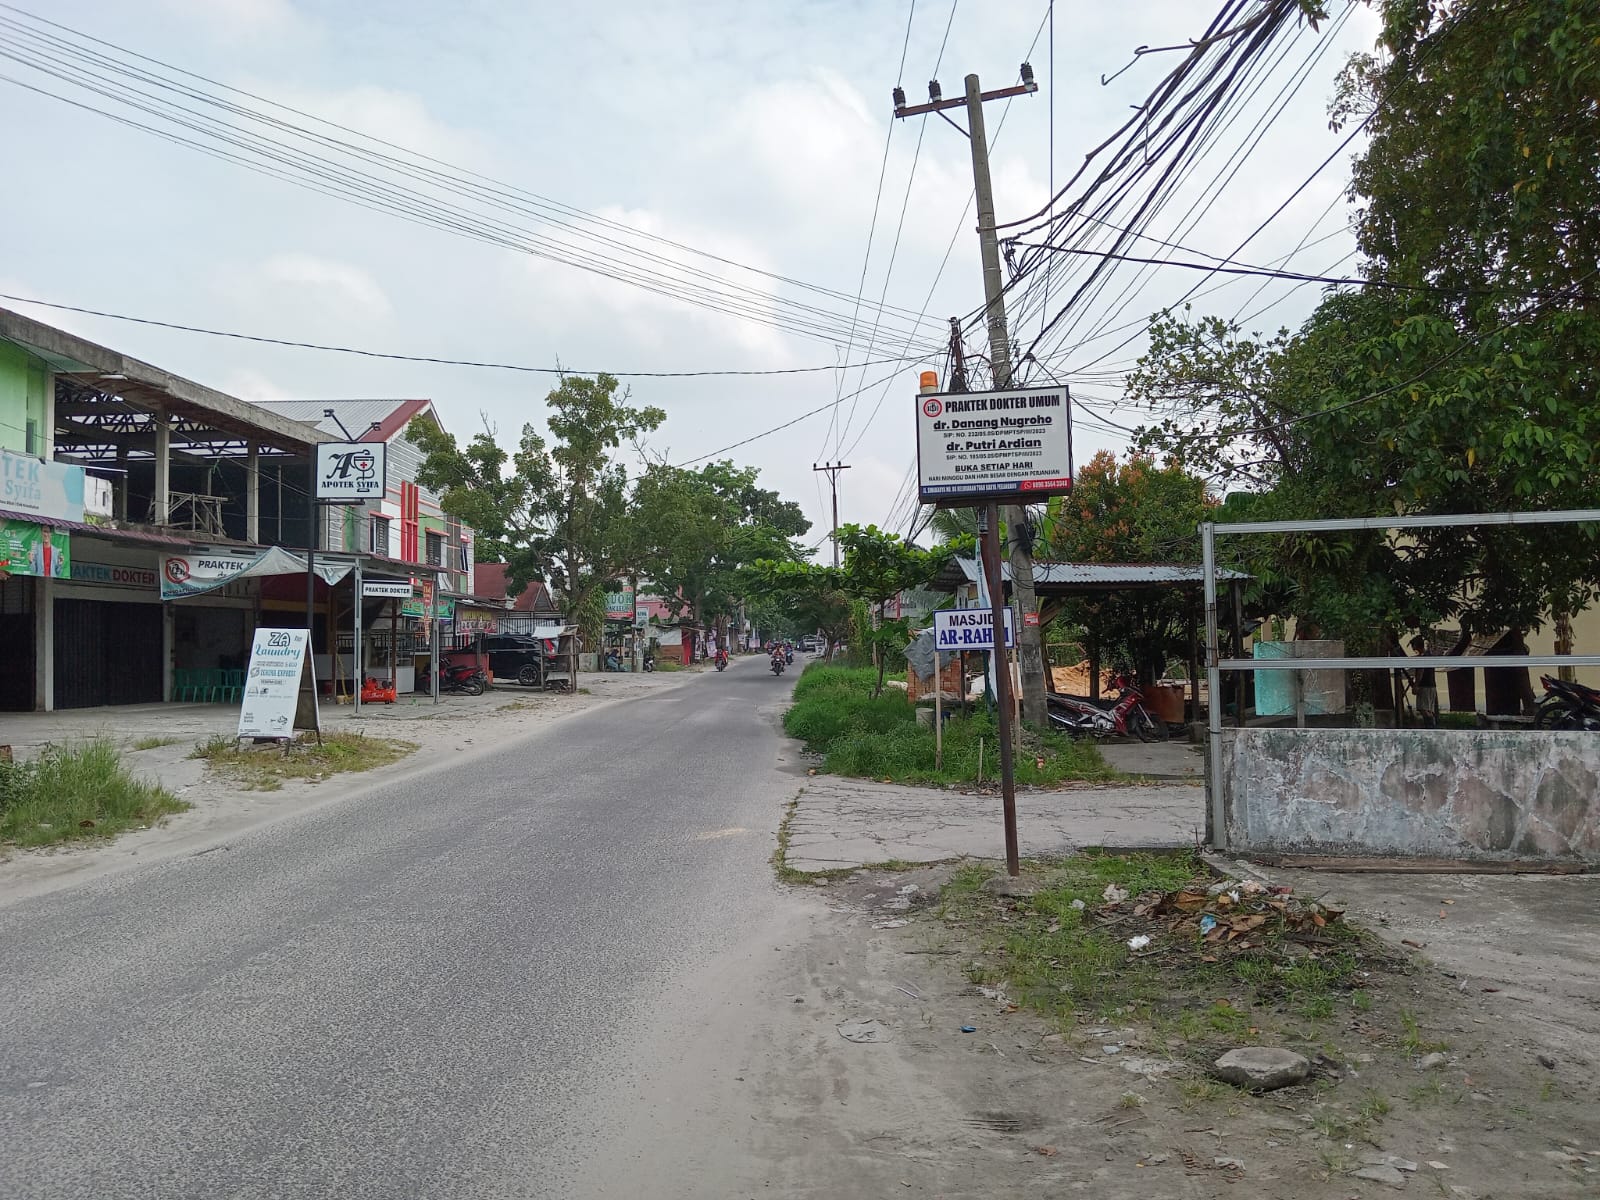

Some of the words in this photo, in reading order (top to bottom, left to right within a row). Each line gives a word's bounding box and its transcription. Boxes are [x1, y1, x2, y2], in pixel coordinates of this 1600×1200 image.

[945, 398, 988, 413] PRAKTEK
[989, 396, 1027, 411] DOKTER
[1028, 394, 1060, 408] UMUM
[933, 420, 950, 430] dr.
[952, 418, 999, 430] Danang
[1000, 414, 1052, 428] Nugroho
[946, 440, 964, 452] dr.
[965, 439, 996, 450] Putri
[998, 437, 1042, 449] Ardian
[955, 464, 978, 472] BUKA
[980, 462, 1010, 471] SETIAP
[1012, 461, 1033, 470] HARI
[941, 474, 964, 482] MINGGU
[1007, 470, 1028, 478] DENGAN
[1030, 469, 1060, 477] PERJANJIAN
[5, 480, 41, 500] Syifa
[356, 480, 379, 488] SYIFA
[198, 560, 244, 570] PRAKTEK
[113, 569, 156, 585] DOKTER
[365, 586, 389, 594] PRAKTEK
[390, 586, 410, 594] DOKTER
[268, 632, 290, 647] ZA
[255, 644, 302, 660] Laundry
